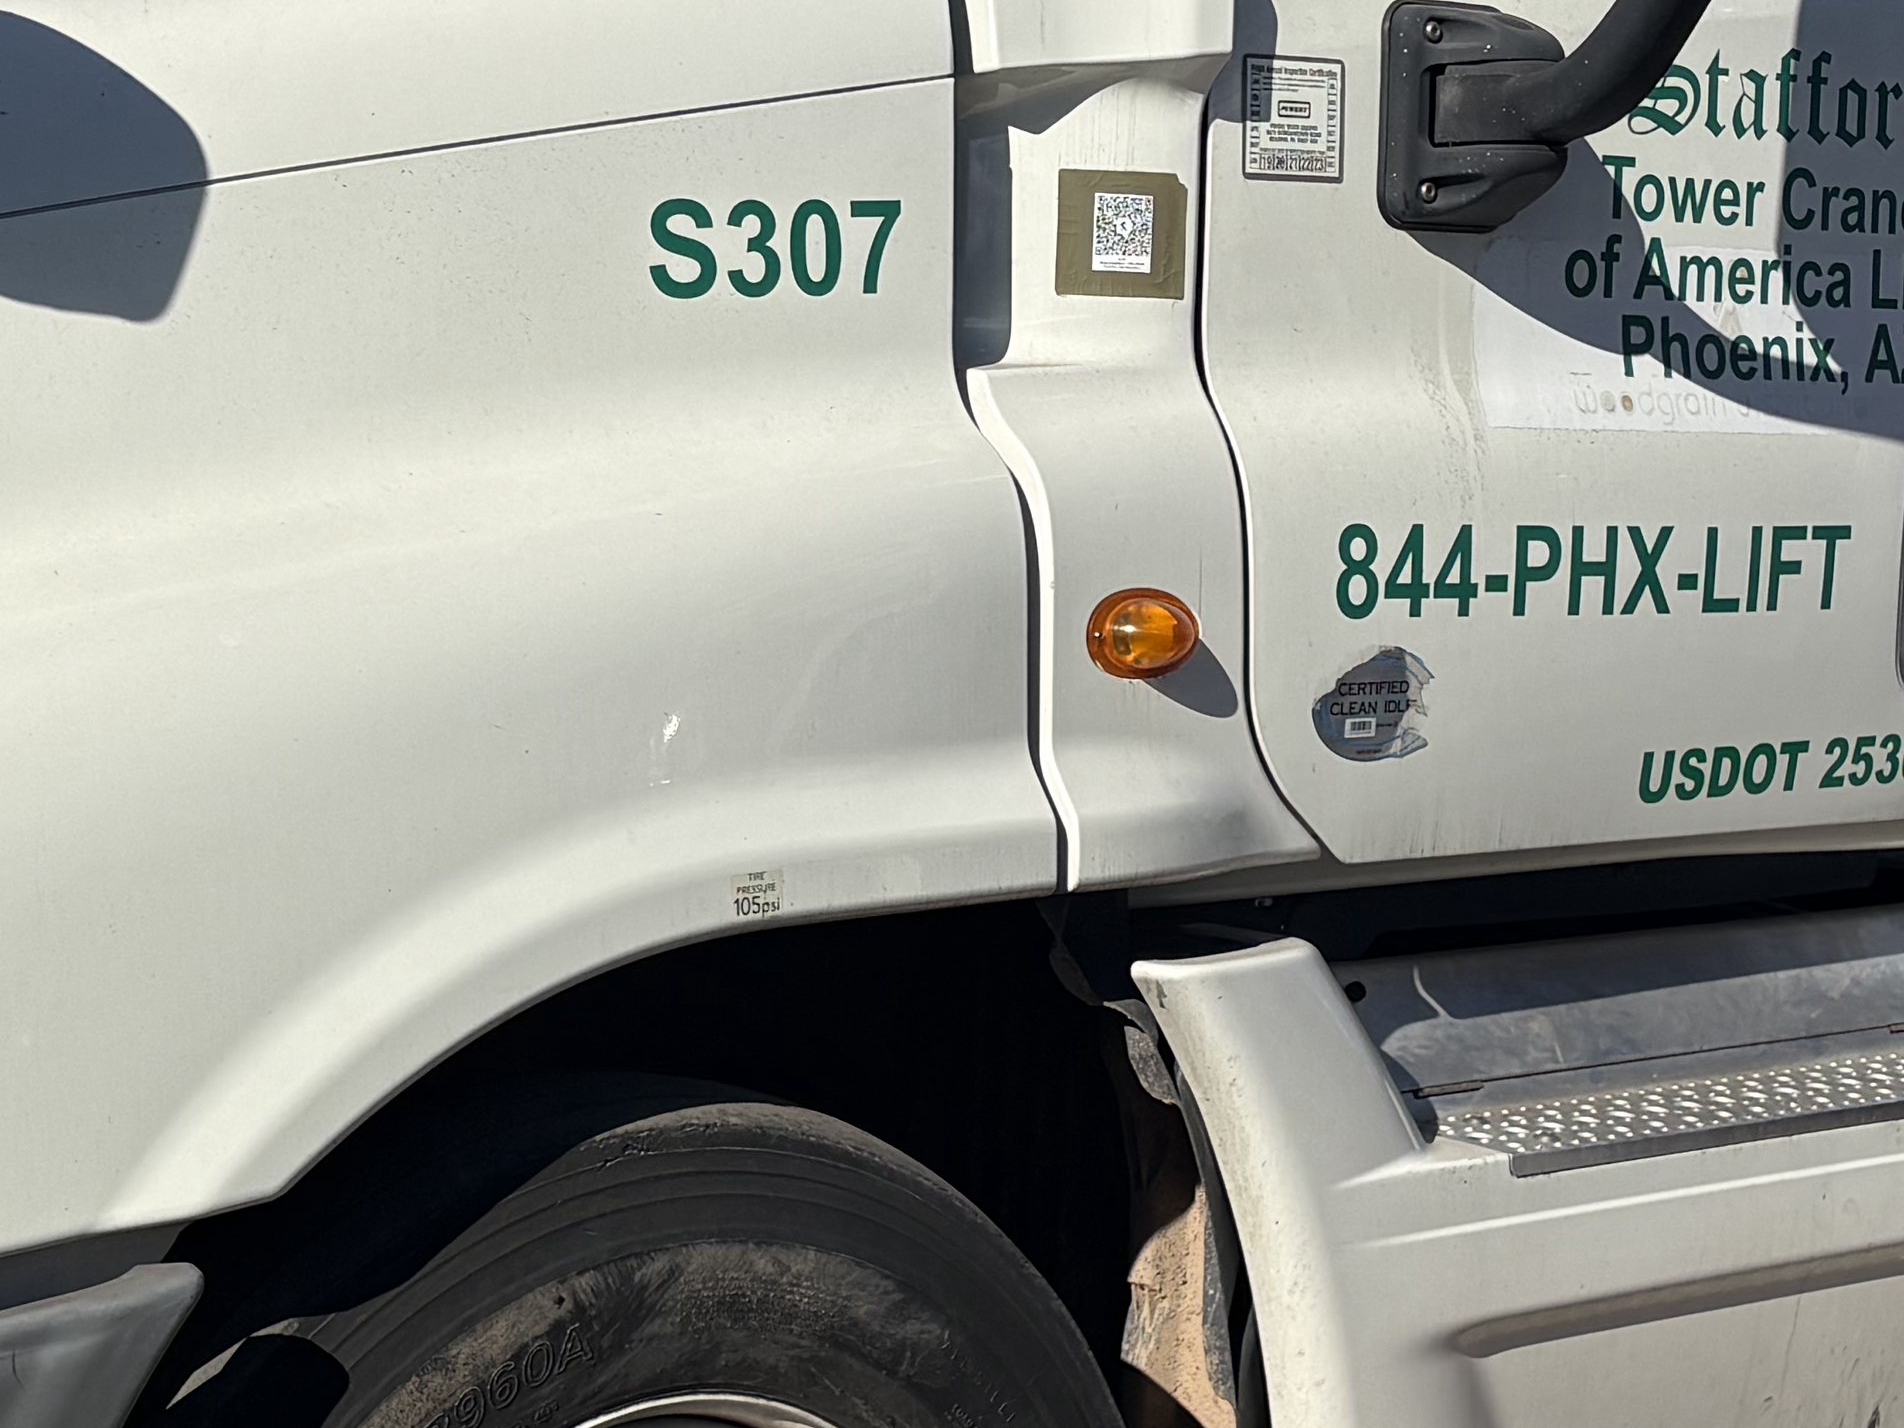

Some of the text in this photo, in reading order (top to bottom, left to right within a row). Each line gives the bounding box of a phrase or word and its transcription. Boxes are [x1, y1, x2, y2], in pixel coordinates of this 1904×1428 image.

[1600, 154, 1766, 227] Tower
[648, 198, 902, 299] S307
[1564, 233, 1624, 299] of
[1632, 238, 1852, 310] America
[1620, 313, 1849, 395] Phoenix,
[1335, 523, 1853, 620] 844-PHX-LIFT
[1329, 700, 1378, 717] CLEAN
[1338, 680, 1410, 697] CERTIFIED
[1639, 740, 1809, 804] USDOT
